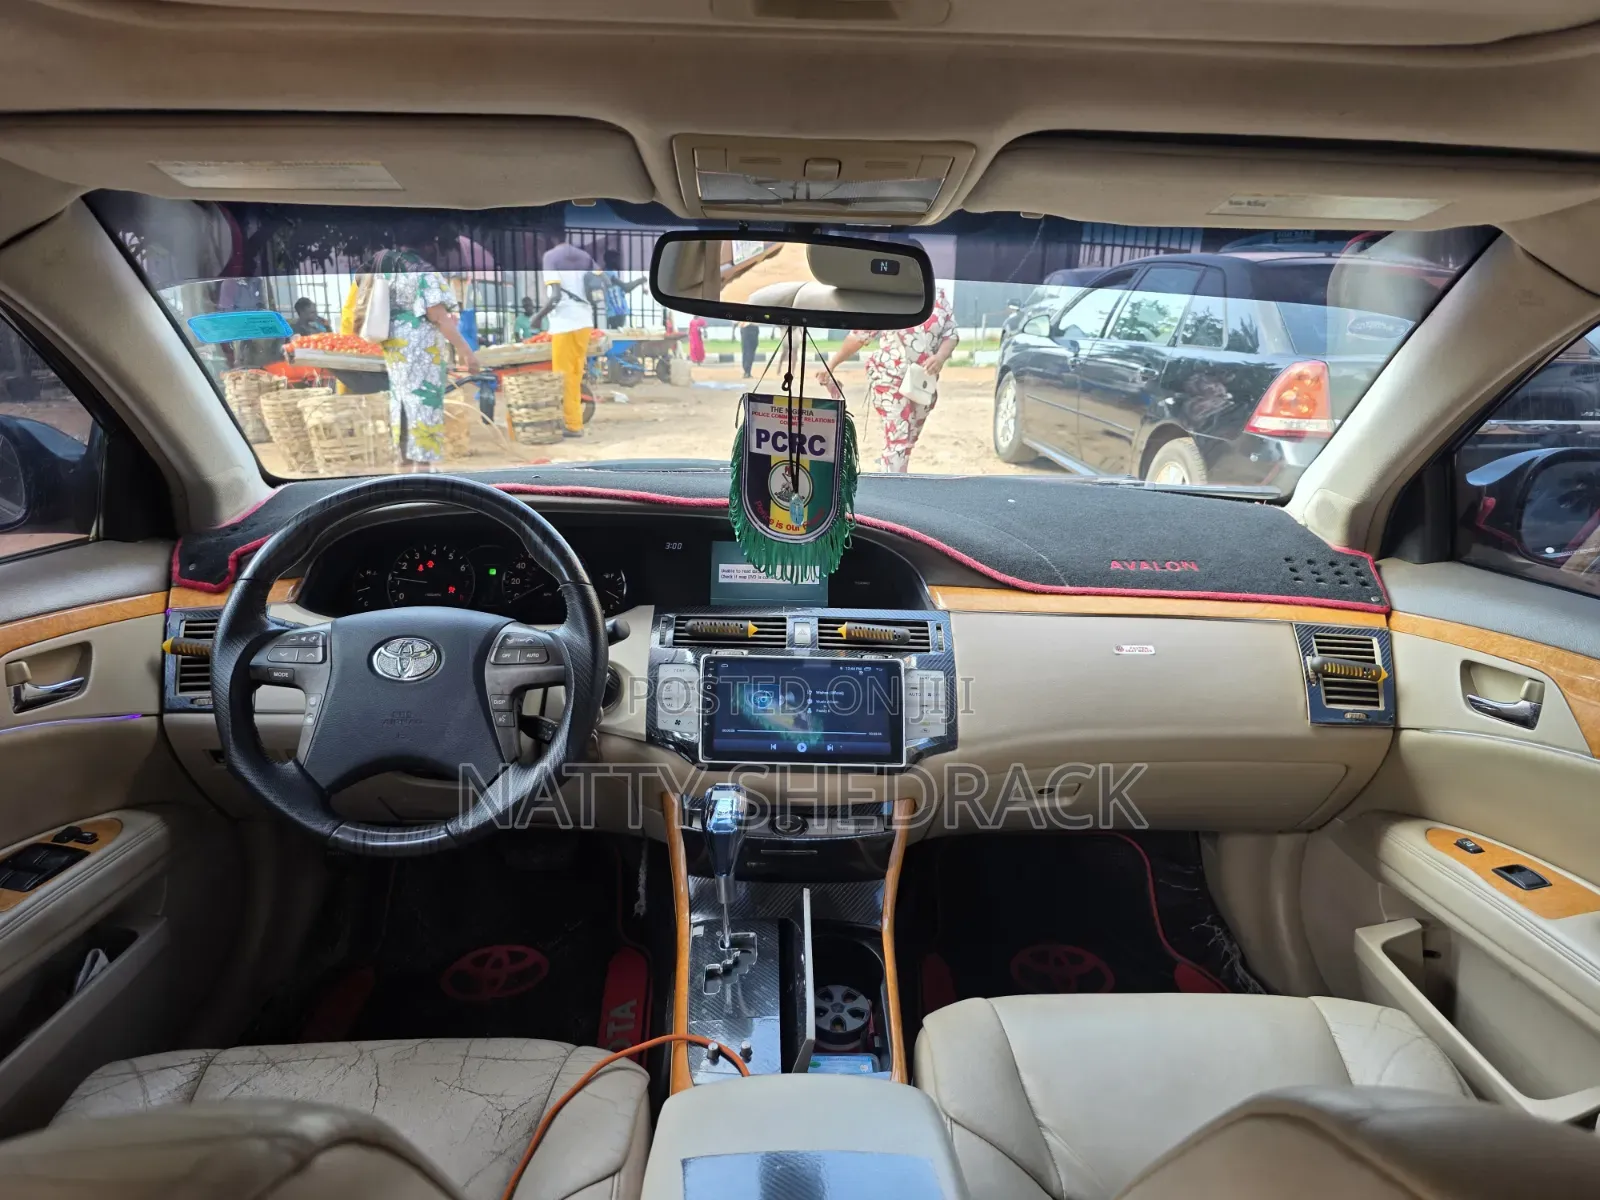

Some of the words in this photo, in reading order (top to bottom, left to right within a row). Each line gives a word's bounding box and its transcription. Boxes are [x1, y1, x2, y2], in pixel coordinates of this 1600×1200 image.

[880, 261, 888, 272] N
[770, 406, 784, 414] THE
[785, 407, 814, 416] NGRIA
[804, 416, 835, 424] RELATIONS
[755, 428, 826, 457] PCRC
[775, 520, 784, 530] is
[665, 541, 683, 550] 3:00
[414, 552, 420, 560] 3
[431, 548, 437, 556] 4
[401, 562, 408, 570] 2
[460, 564, 466, 572] 6
[515, 562, 526, 570] 40
[1110, 560, 1200, 572] AVALON
[398, 592, 405, 600] 0
